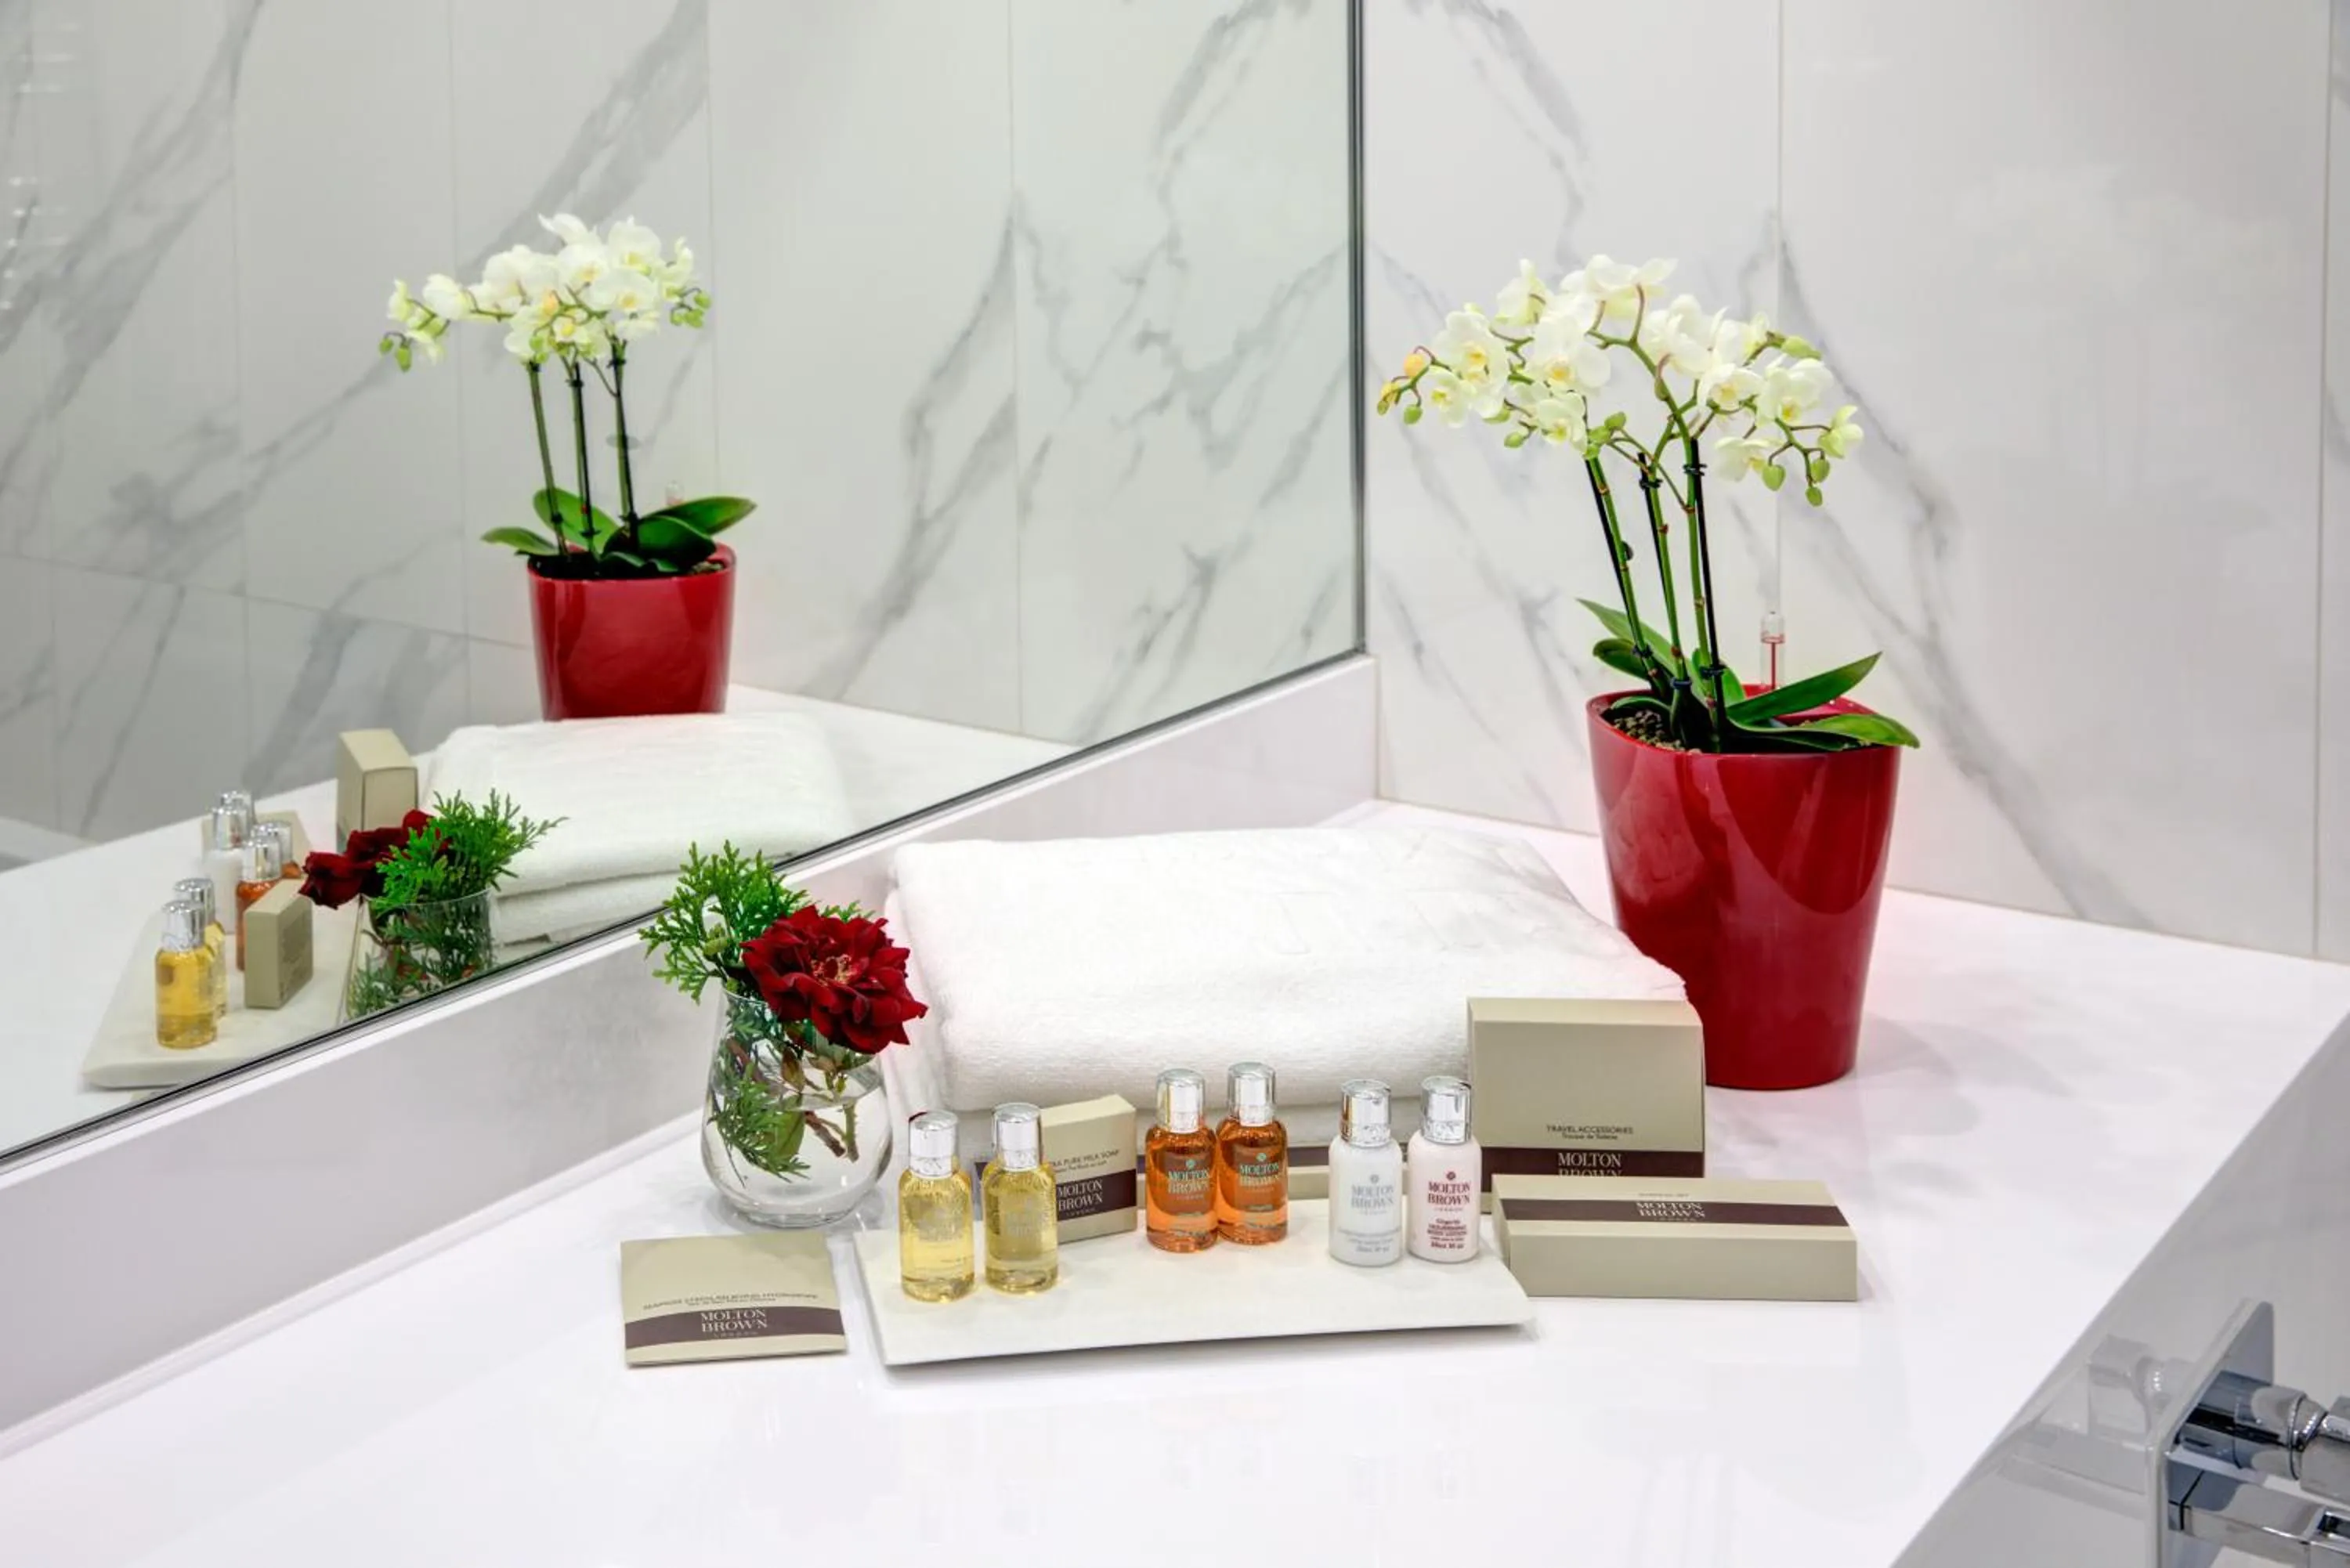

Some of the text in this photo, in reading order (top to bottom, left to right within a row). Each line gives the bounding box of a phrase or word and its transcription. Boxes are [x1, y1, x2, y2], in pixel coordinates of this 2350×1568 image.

[1558, 1152, 1622, 1167] MOLTON
[1168, 1168, 1210, 1181] MOLTON
[1240, 1162, 1279, 1175] MOLTON
[1058, 1179, 1103, 1198] MOLTON
[1168, 1180, 1209, 1194] BROWN
[1351, 1184, 1394, 1197] MOLTON
[1428, 1181, 1470, 1193] MOLTON
[1058, 1191, 1103, 1211] BROWN
[1351, 1196, 1394, 1209] BROWN
[1427, 1193, 1470, 1205] BROWN
[1638, 1209, 1705, 1218] BROWN
[700, 1309, 766, 1323] MOLTON
[701, 1319, 768, 1333] BROWN
